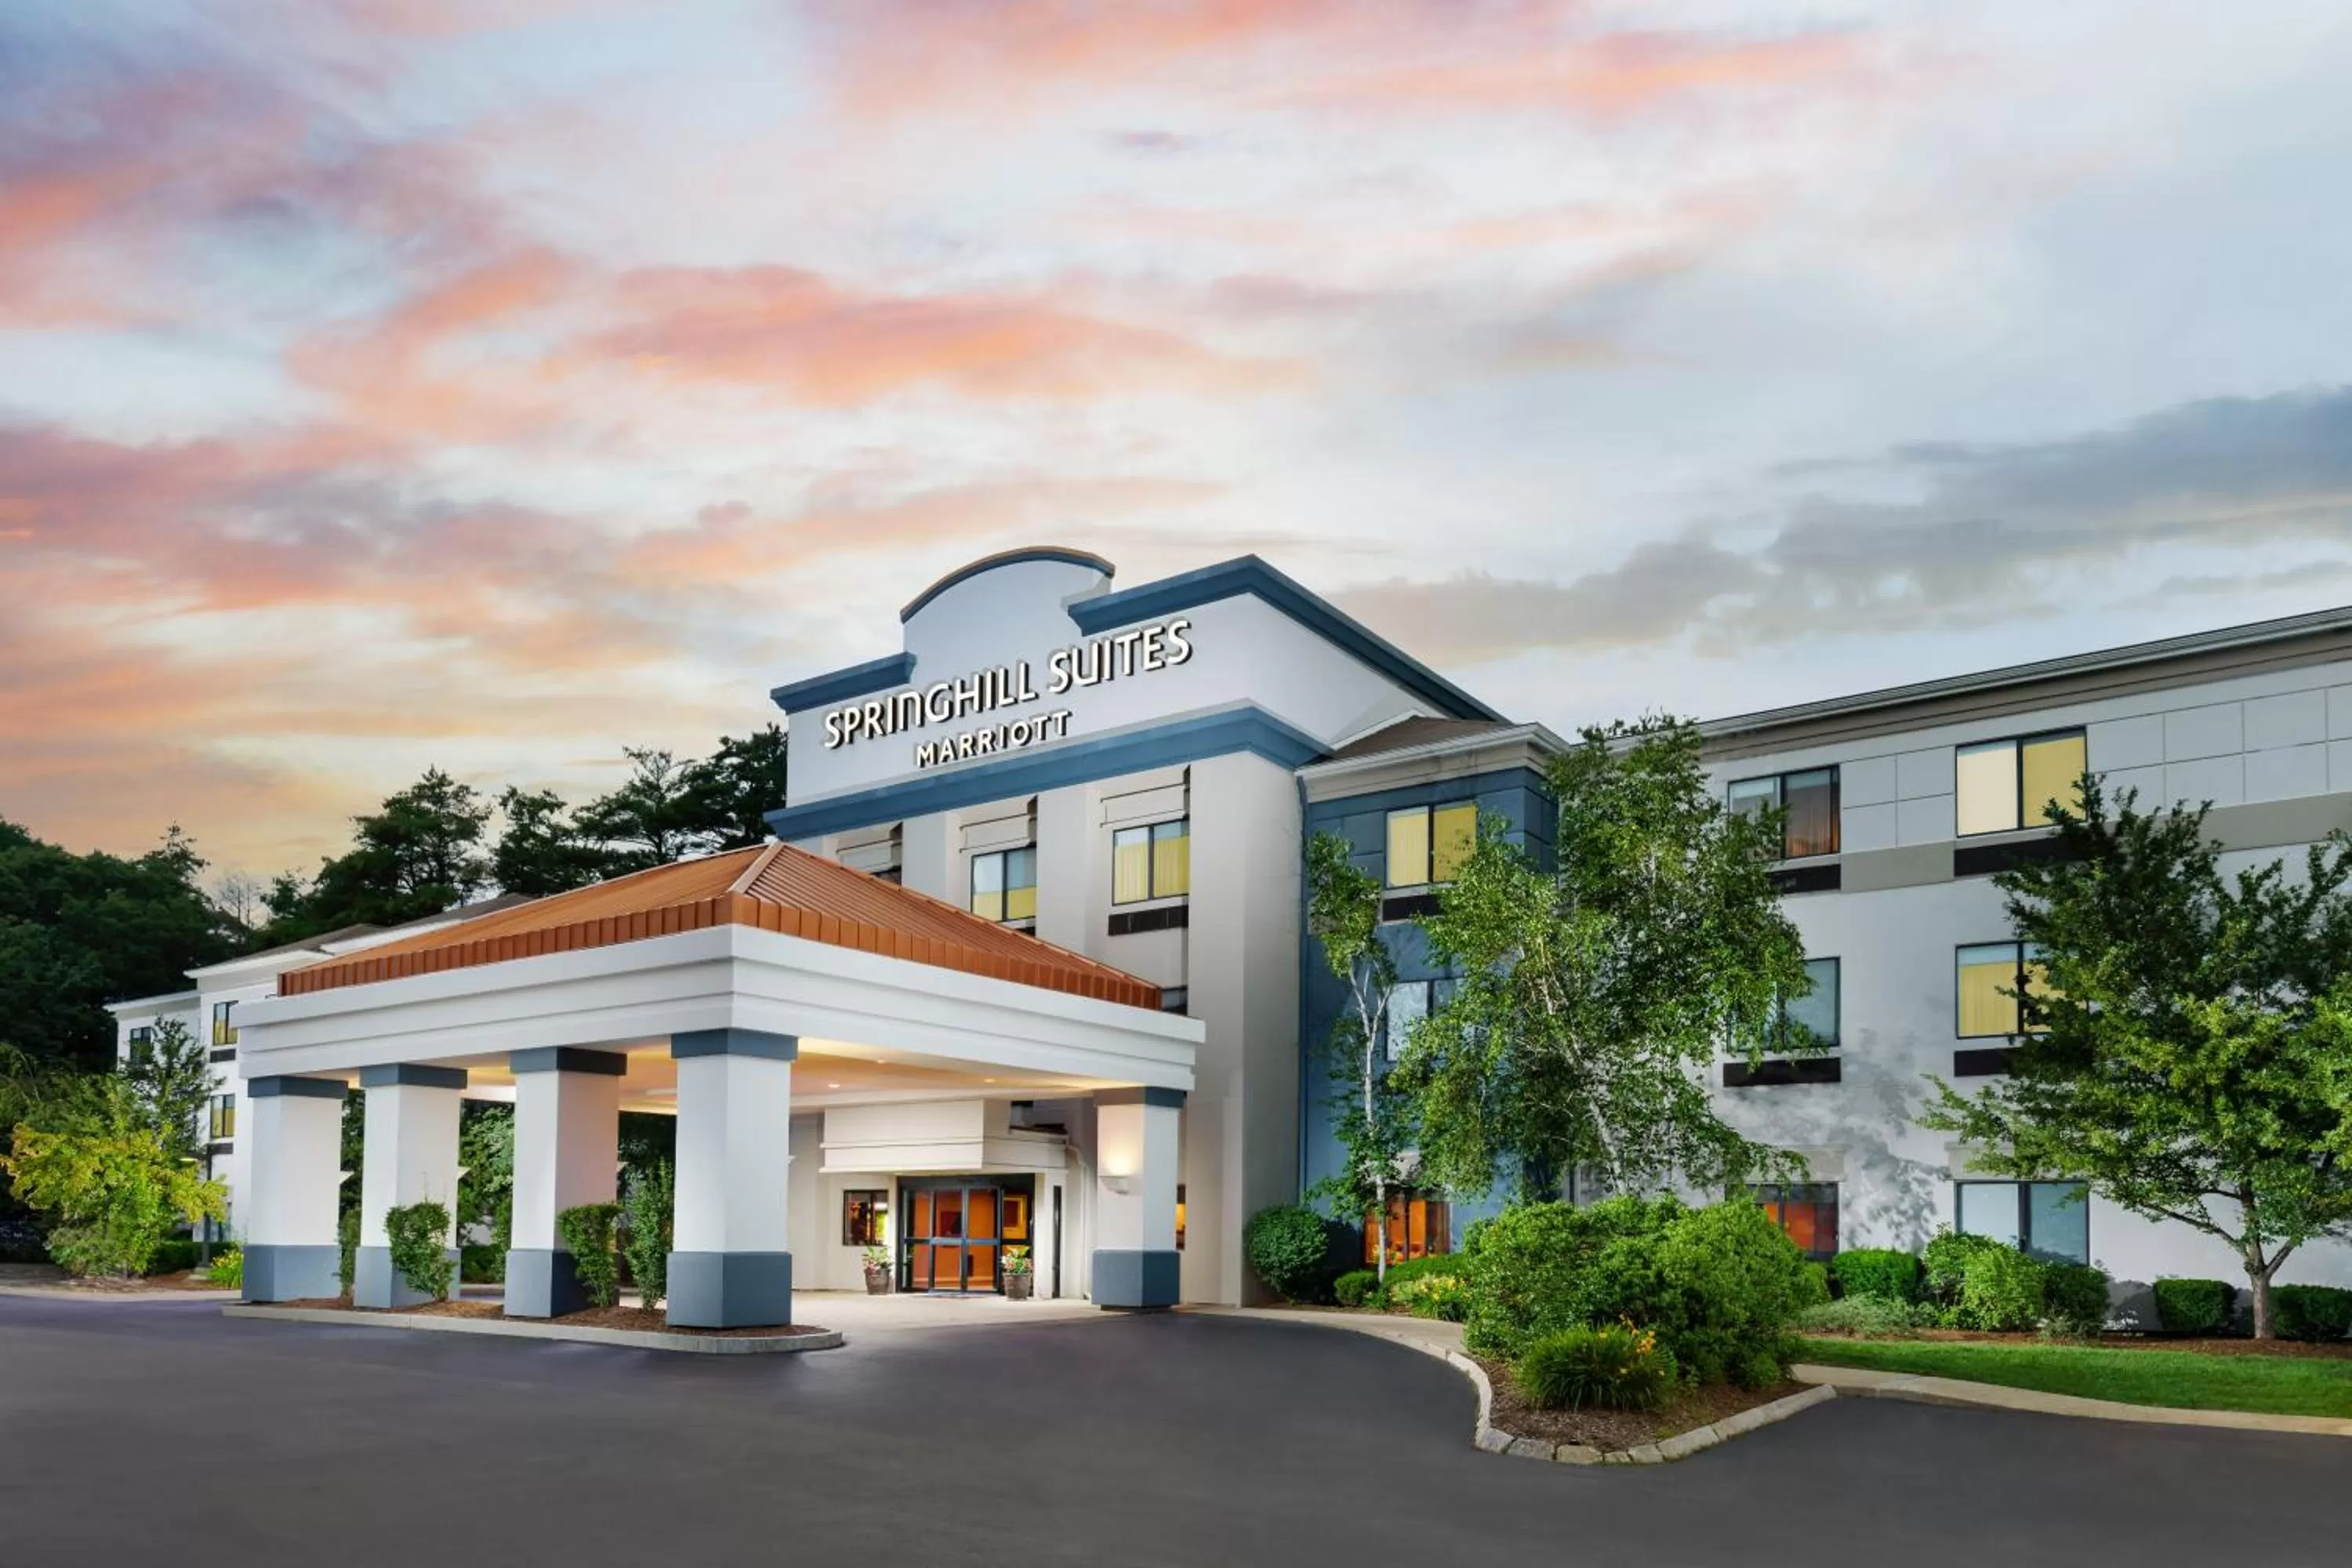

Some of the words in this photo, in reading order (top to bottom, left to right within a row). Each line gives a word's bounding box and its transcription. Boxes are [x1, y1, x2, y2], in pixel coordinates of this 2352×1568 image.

[824, 661, 1038, 749] SPRINGHILL
[1047, 620, 1193, 694] SUITES
[916, 710, 1072, 768] MARRIOTT
